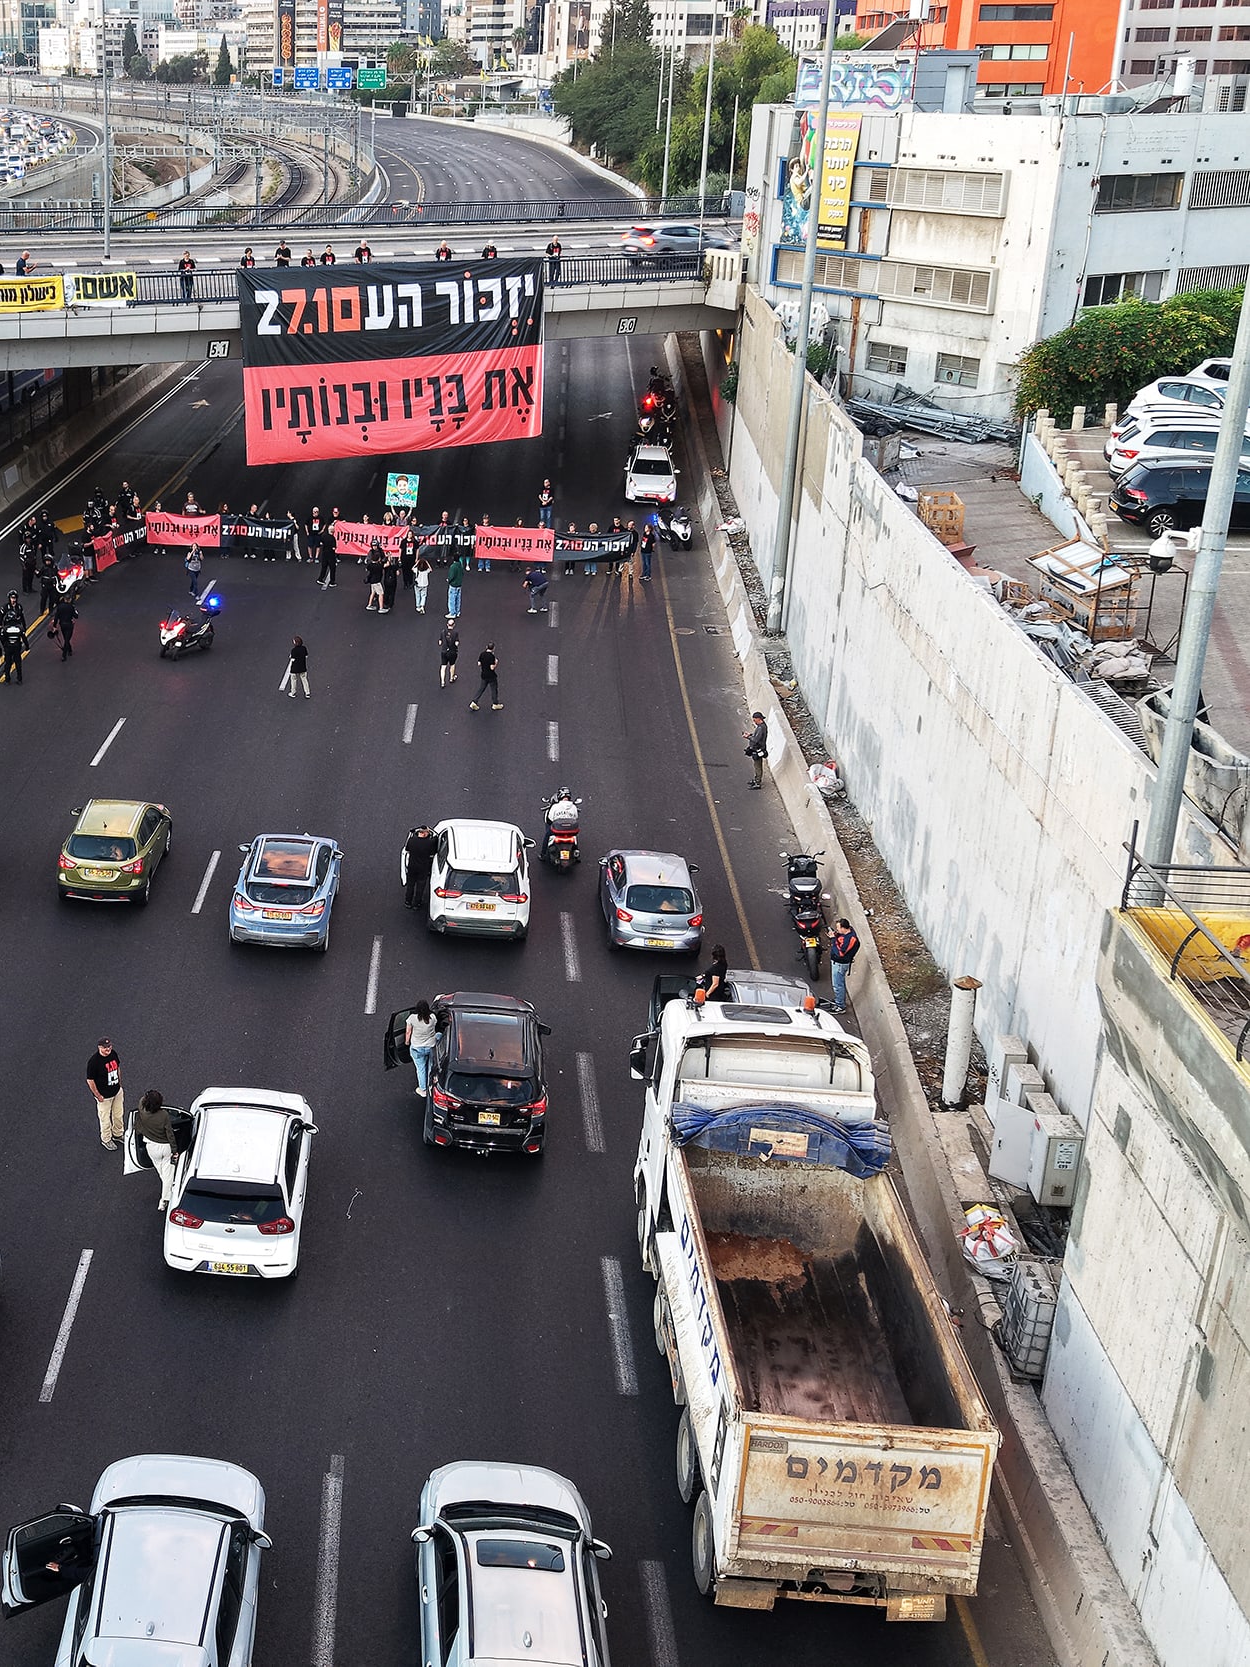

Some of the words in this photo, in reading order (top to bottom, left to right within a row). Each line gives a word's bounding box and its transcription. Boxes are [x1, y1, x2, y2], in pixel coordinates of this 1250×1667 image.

[824, 137, 852, 151] הרבה
[826, 157, 850, 170] יותר
[828, 177, 846, 191] כיף
[20, 284, 56, 304] כישלון
[75, 275, 135, 300] אשם!
[681, 1213, 721, 1387] מקדמים
[750, 1440, 784, 1450] HARDOX
[785, 1454, 943, 1493] מקדמים
